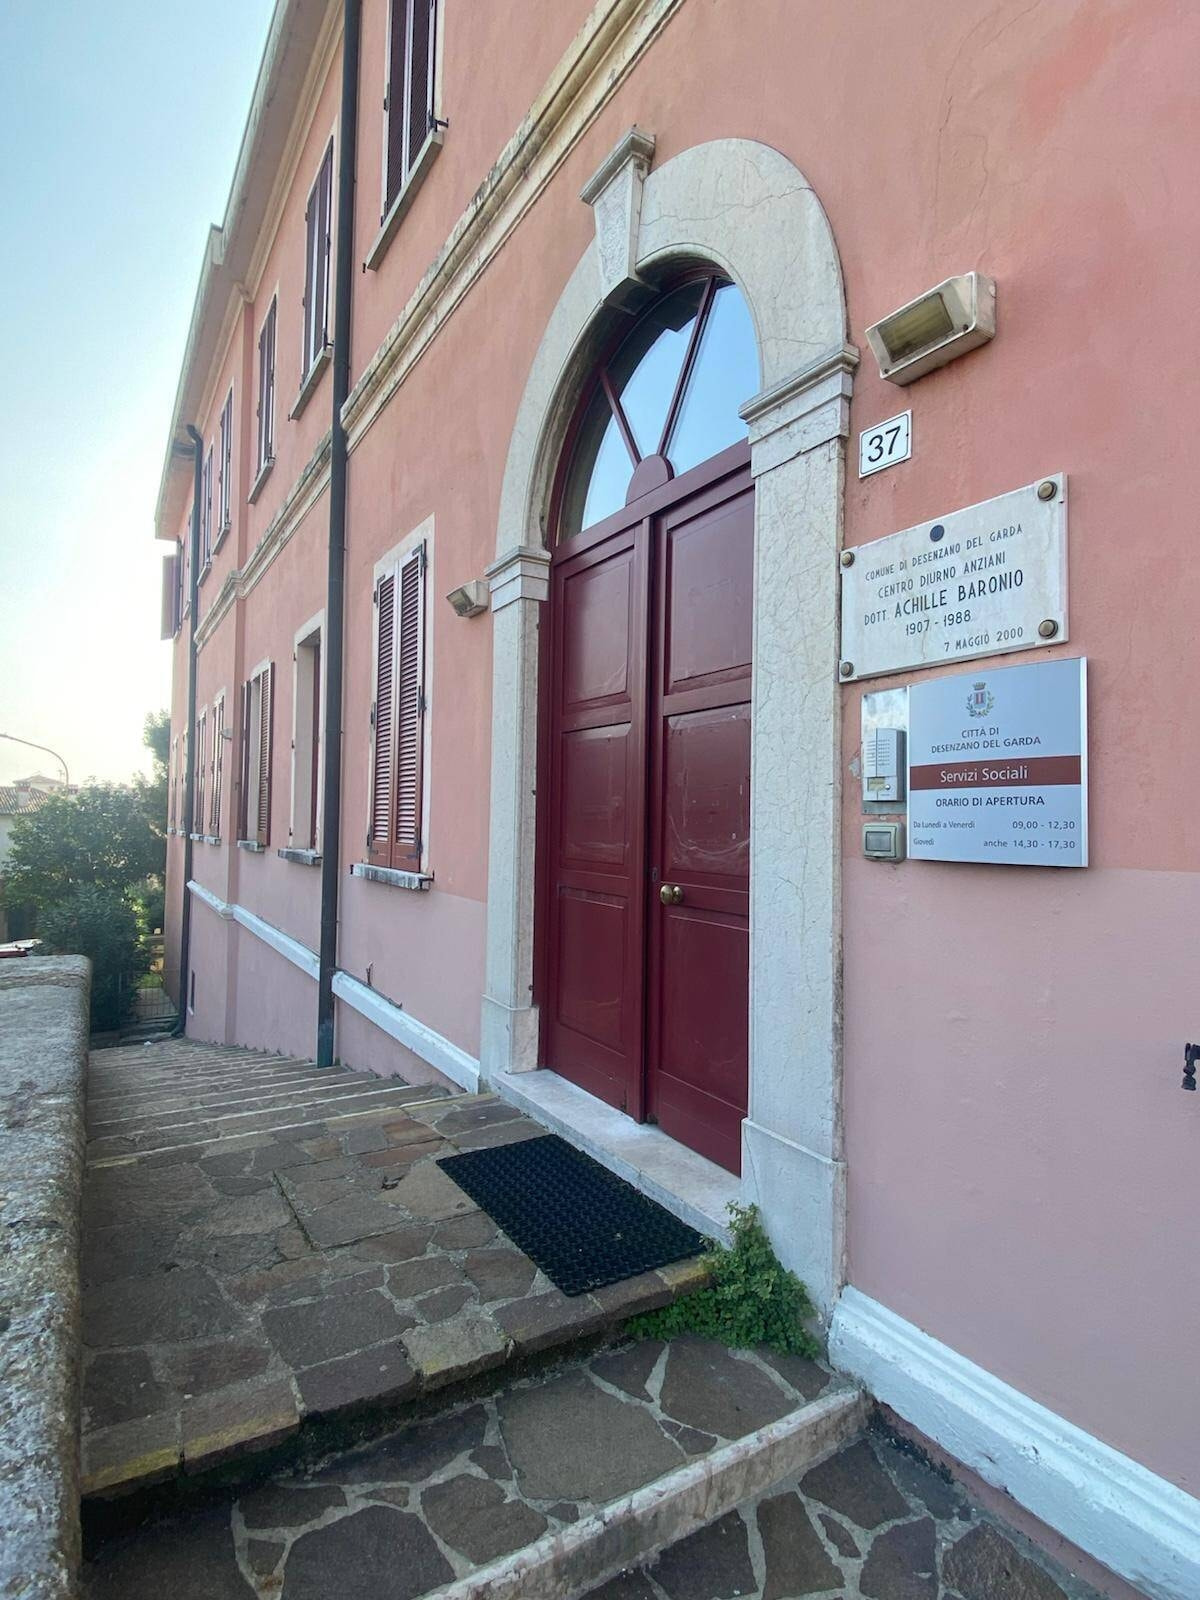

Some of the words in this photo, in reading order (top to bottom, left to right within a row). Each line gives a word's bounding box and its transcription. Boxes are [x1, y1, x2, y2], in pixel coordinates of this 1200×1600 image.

[867, 425, 901, 463] 37
[865, 564, 895, 581] COMUNE
[899, 560, 908, 571] DI
[912, 543, 961, 567] DESENZANO
[966, 536, 983, 550] DEL
[989, 523, 1023, 542] GARDA
[878, 578, 914, 599] CENTRO
[920, 566, 956, 587] DIURNO
[963, 551, 1006, 575] ANZIANI
[894, 589, 947, 618] ACHILLE
[958, 569, 1023, 602] BARONIO
[905, 619, 930, 636] 1907
[943, 609, 971, 627] 1988
[944, 641, 950, 652] 7
[955, 633, 990, 650] MAGGIO
[996, 626, 1023, 642] 2000
[989, 727, 999, 736] DI
[931, 741, 980, 754] DESENZANO
[982, 739, 1001, 749] DEL
[1003, 736, 1042, 748] GARDA
[940, 769, 978, 783] Servizi
[981, 765, 1028, 781] Sociali
[935, 798, 970, 807] ORARIO
[972, 797, 983, 807] DI
[985, 795, 1045, 806] APERTURA
[913, 821, 921, 829] Da
[1012, 821, 1038, 830] 09,00
[1048, 821, 1076, 831] 12,30
[983, 839, 1009, 848] anche
[1012, 840, 1038, 849] 14,30
[1048, 840, 1077, 850] 17,30
